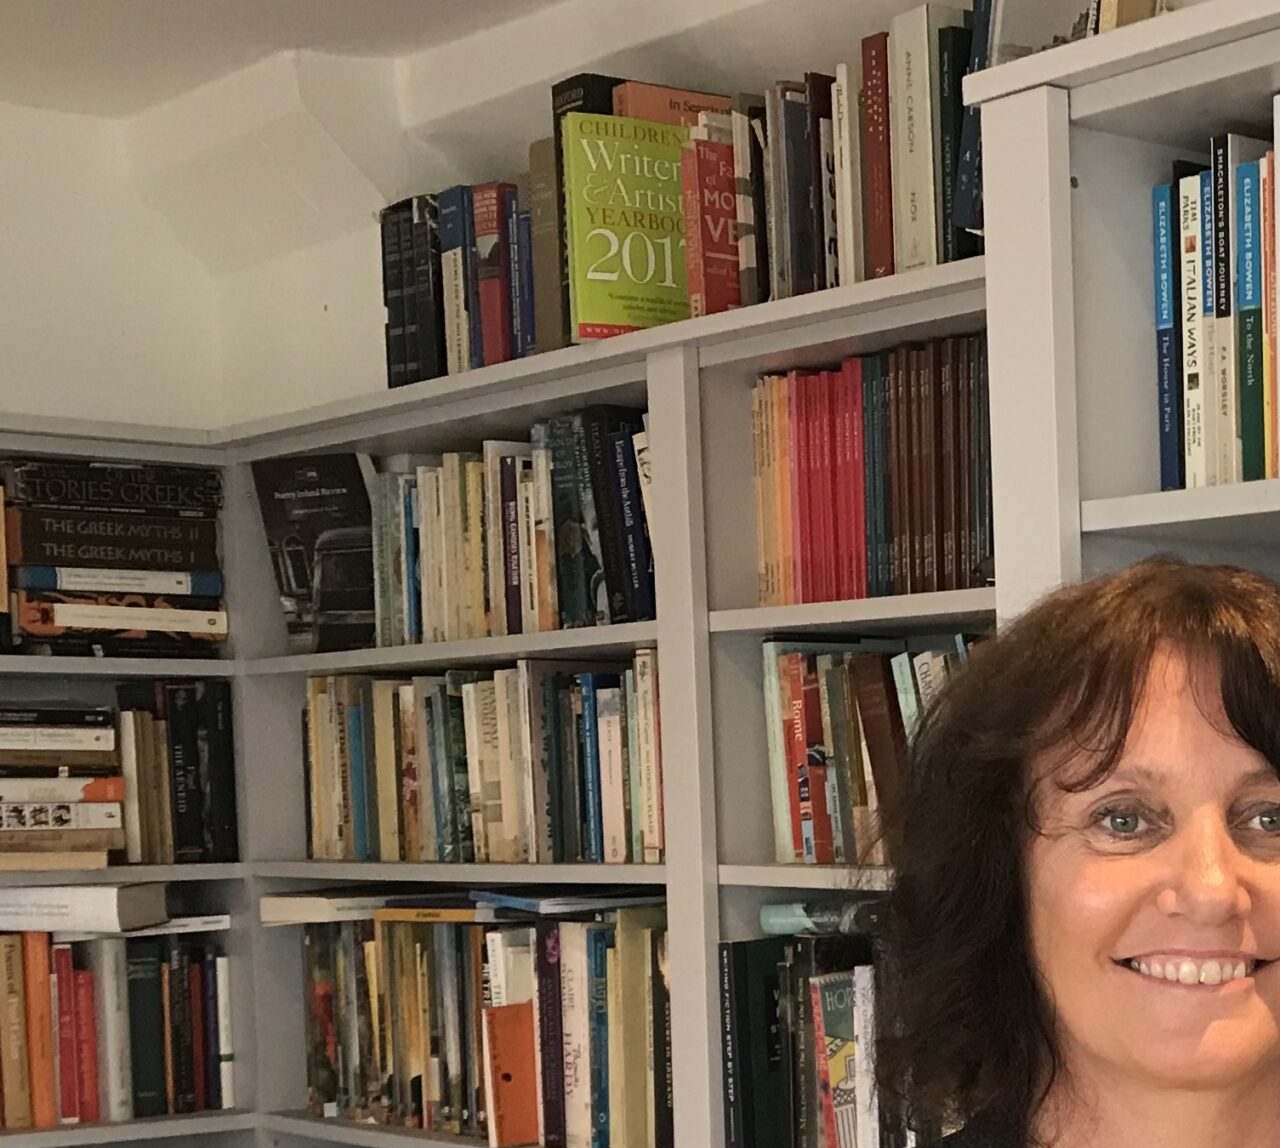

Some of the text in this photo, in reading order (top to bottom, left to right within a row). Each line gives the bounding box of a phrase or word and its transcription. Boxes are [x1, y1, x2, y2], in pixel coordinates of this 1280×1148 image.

[906, 95, 916, 154] CARSON
[1158, 200, 1169, 321] ELIZABETH BOWEN
[1202, 185, 1213, 308] ELIZABETH BOWEN
[1218, 235, 1226, 264] BOAT
[1243, 177, 1253, 301] ELIZABETH BOWEN
[1186, 259, 1197, 368] ITALIAN WAYS
[77, 520, 126, 537] GREEK
[128, 524, 183, 540] MYTHS
[78, 545, 127, 561] GREEK
[129, 548, 184, 565] MYTHS
[791, 698, 803, 742] Rome
